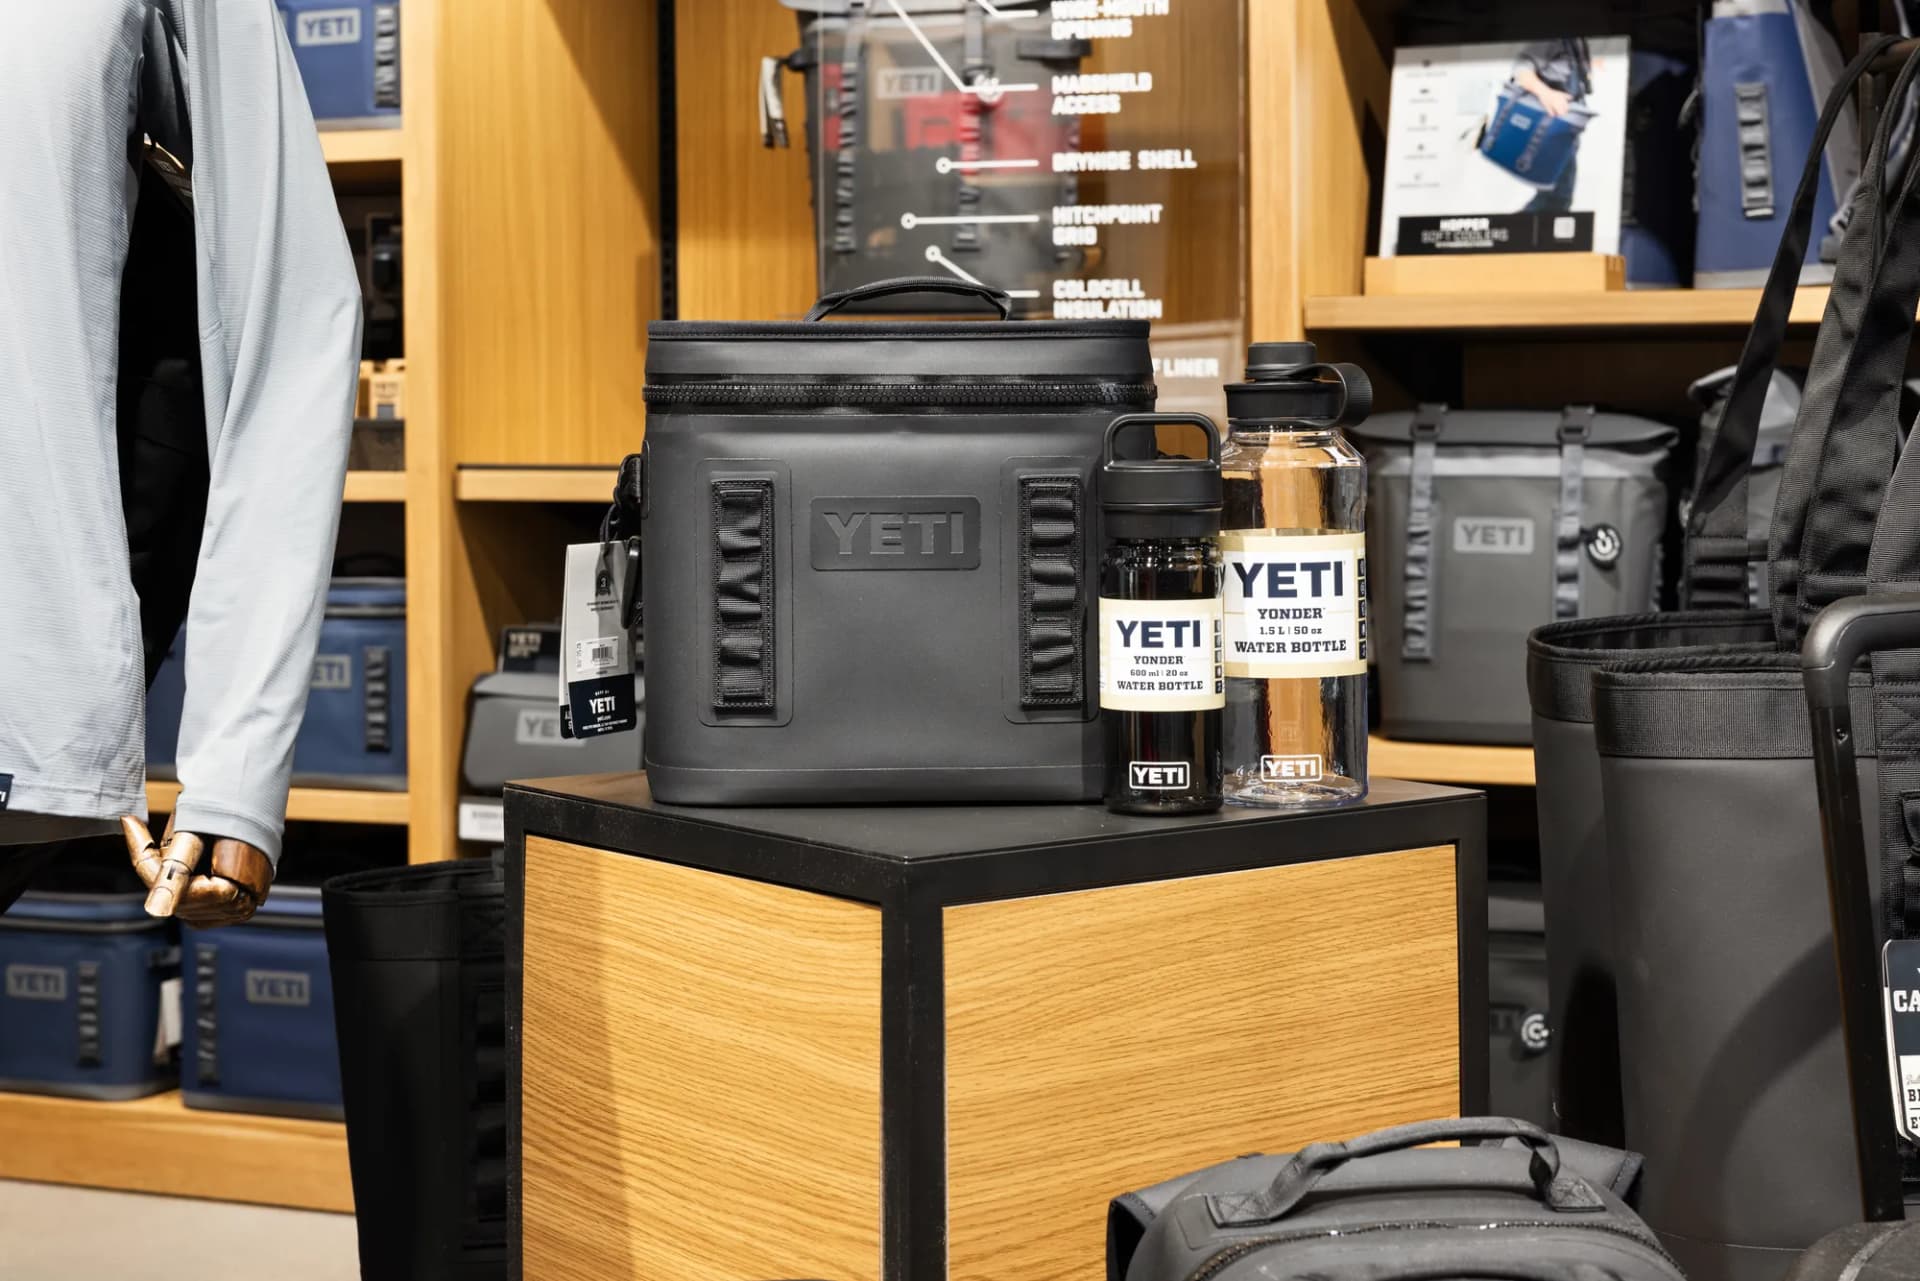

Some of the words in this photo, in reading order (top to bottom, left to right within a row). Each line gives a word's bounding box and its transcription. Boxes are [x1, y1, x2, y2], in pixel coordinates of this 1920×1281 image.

[303, 16, 354, 37] YETI
[883, 73, 935, 92] YETI
[1052, 94, 1121, 115] ACCESS
[1138, 149, 1197, 170] SHELL
[1053, 279, 1145, 299] COLDCELL
[1053, 299, 1162, 319] INSULATION
[1163, 358, 1219, 378] LINER
[823, 511, 964, 555] YETI
[1461, 524, 1526, 546] YETI
[1232, 561, 1344, 598] YETI
[1257, 608, 1323, 620] YONDER
[1116, 620, 1201, 648] YETI
[1260, 627, 1276, 635] 1.5
[1294, 626, 1308, 635] 50
[1234, 641, 1287, 653] WATER
[1291, 640, 1347, 653] BOTTLE
[1133, 656, 1184, 665] YONDER
[1166, 669, 1177, 677] 20
[1117, 681, 1155, 690] WATER
[1158, 681, 1204, 690] BOTTLE
[589, 696, 616, 714] YETI
[1133, 766, 1185, 785] YETI
[1265, 760, 1317, 778] YETI
[13, 972, 61, 993] YETI
[252, 977, 304, 998] YETI
